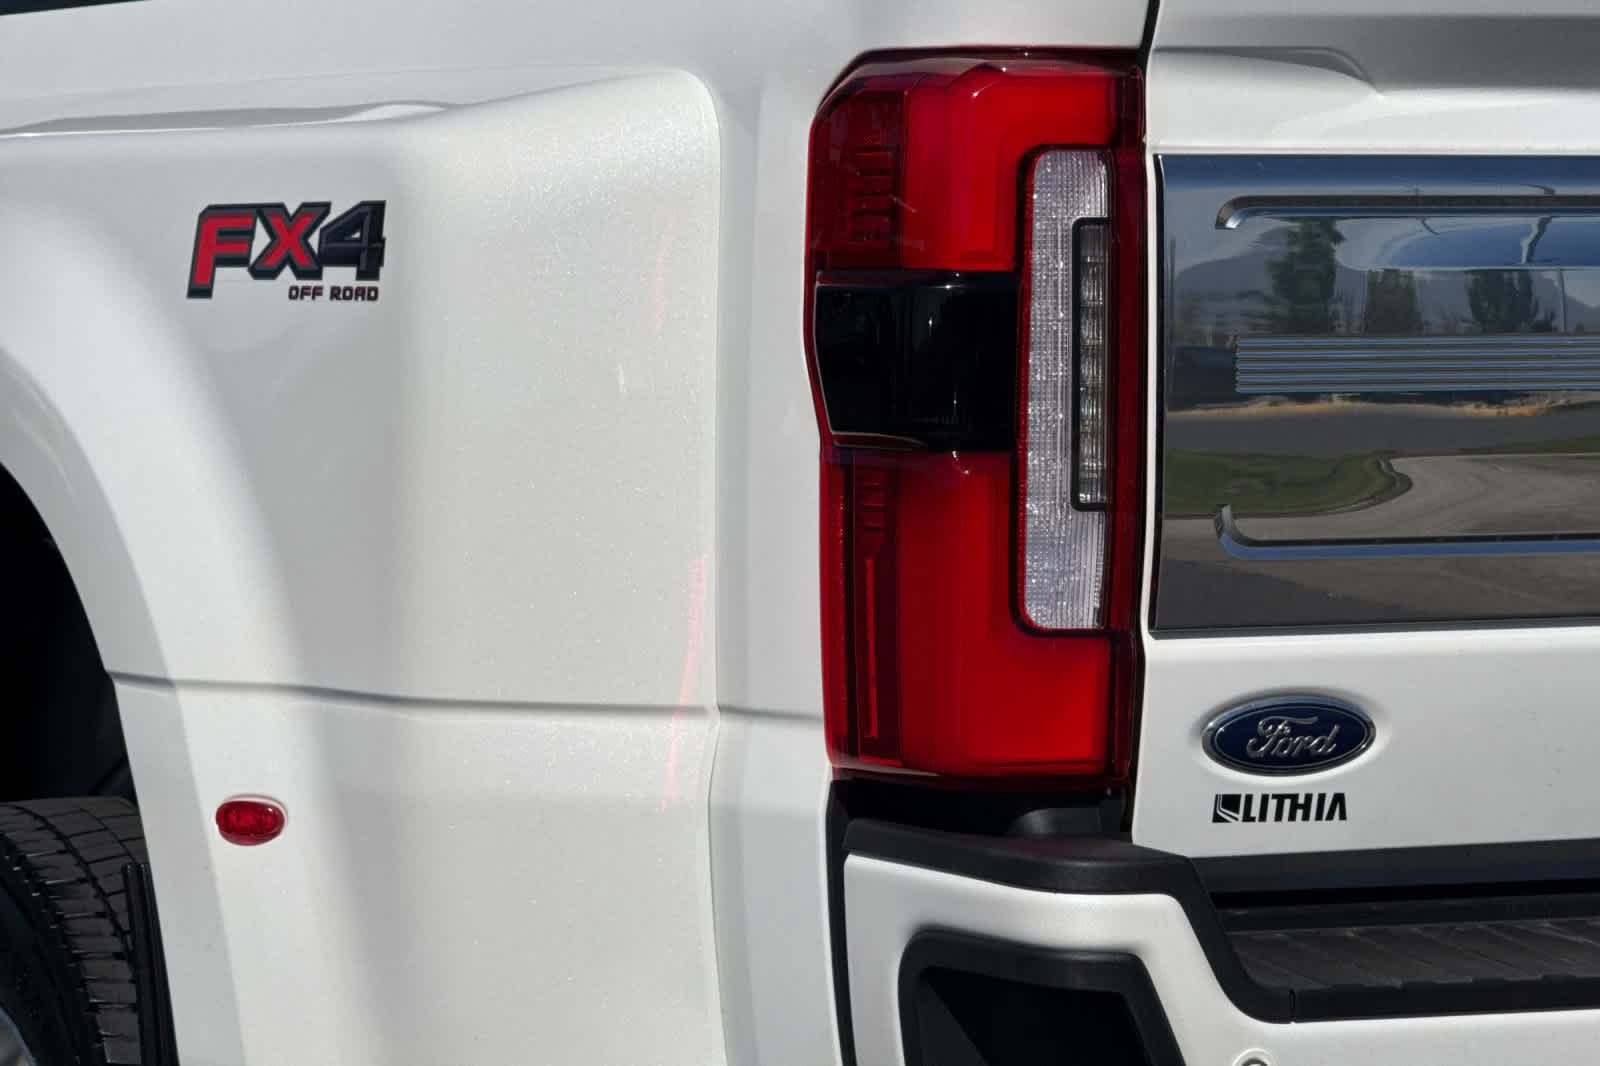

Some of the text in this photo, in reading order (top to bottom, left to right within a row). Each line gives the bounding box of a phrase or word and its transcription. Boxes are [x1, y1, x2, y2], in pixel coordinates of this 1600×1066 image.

[187, 200, 386, 299] FX4
[288, 286, 379, 301] OFF ROAD
[1246, 716, 1340, 757] Ford
[1242, 793, 1347, 822] LITHIA
